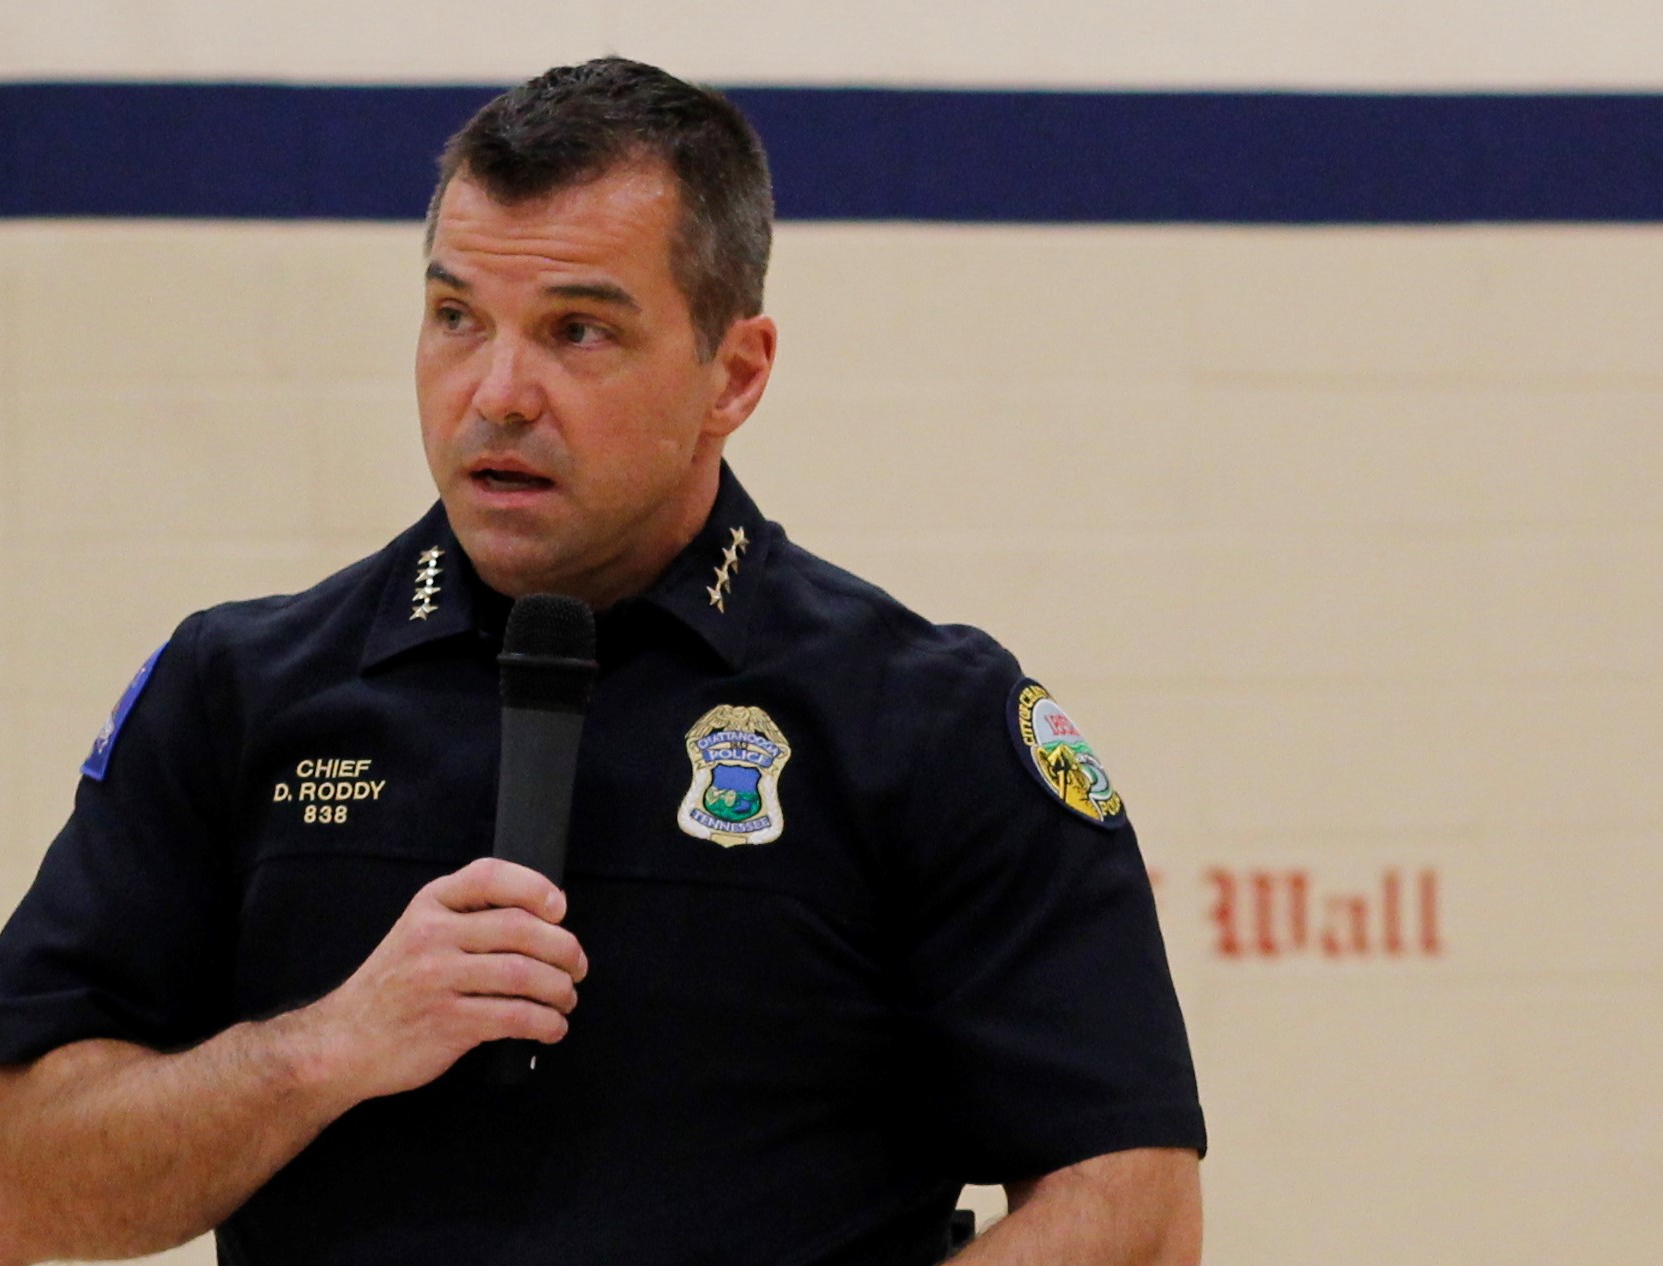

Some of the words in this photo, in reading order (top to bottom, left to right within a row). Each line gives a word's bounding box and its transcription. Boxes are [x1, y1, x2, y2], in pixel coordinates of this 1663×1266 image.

[708, 748, 768, 765] POLICE
[295, 758, 372, 778] CHIEF
[273, 782, 293, 802] D.
[299, 780, 386, 801] RODDY
[303, 804, 348, 824] 838
[693, 810, 770, 833] TENNESSEE
[1204, 866, 1443, 957] Wall
